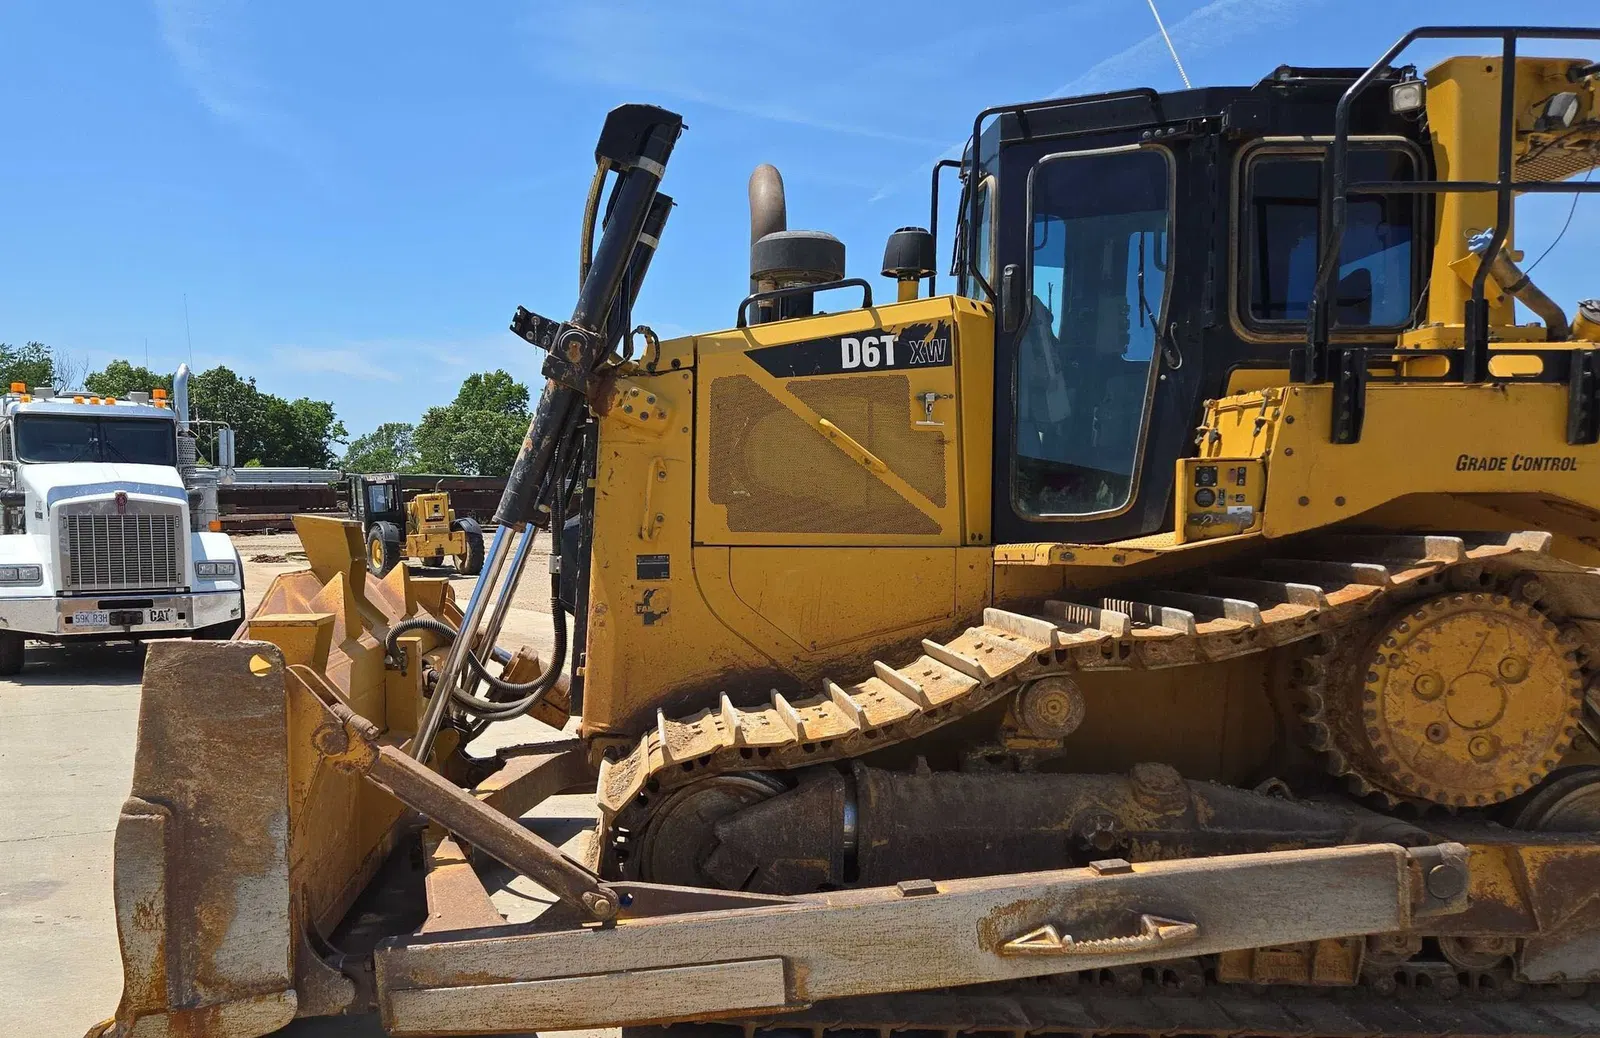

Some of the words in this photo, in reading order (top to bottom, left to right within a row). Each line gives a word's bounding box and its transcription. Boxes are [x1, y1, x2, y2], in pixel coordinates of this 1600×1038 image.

[841, 335, 899, 369] D6T
[909, 339, 946, 364] XW
[75, 613, 90, 624] 59K
[149, 609, 171, 622] CAT
